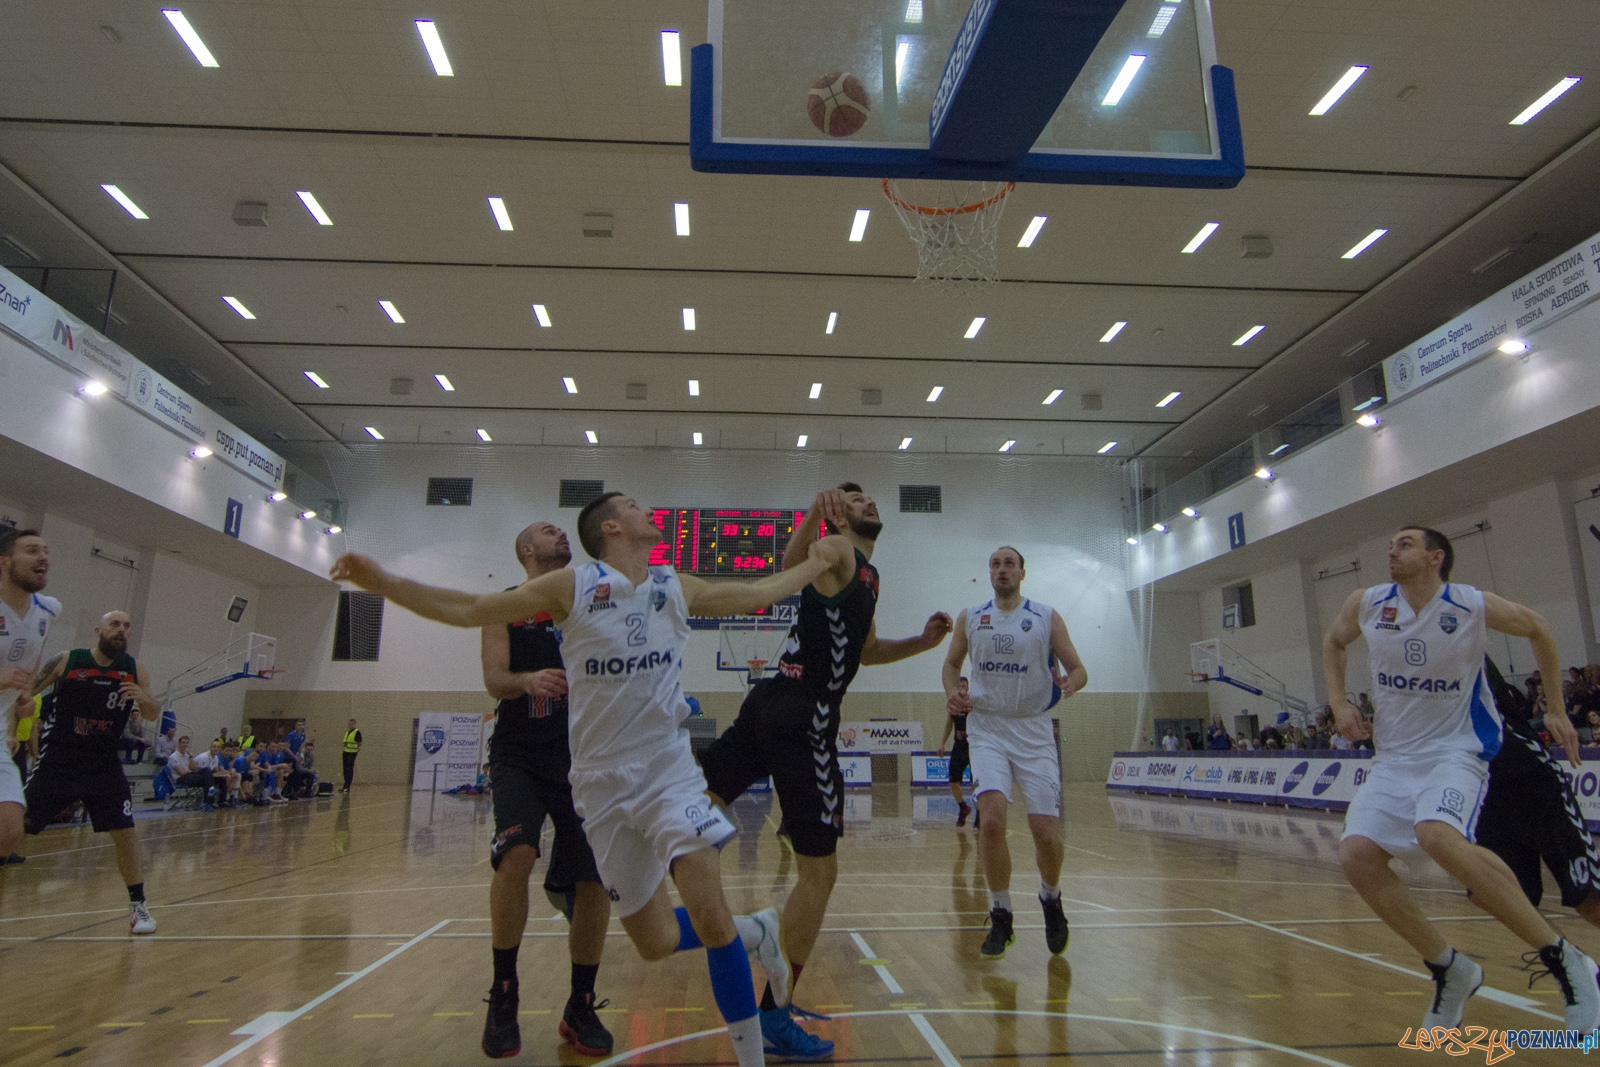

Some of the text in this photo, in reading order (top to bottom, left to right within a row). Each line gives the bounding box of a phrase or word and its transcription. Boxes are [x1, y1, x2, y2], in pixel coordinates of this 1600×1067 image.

[1511, 281, 1535, 302] HALA
[1536, 252, 1584, 287] SPORTOWA
[1516, 280, 1590, 329] BOISKA AEROBIK
[1417, 322, 1473, 359] Centrum Sportu
[1420, 349, 1460, 376] Politechniki
[1462, 321, 1508, 354] Poznańskiej
[156, 383, 177, 405] Centrum
[177, 396, 193, 414] Sportu
[216, 430, 283, 482] cspp.put.poznan.pl
[722, 524, 739, 537] 33
[757, 524, 774, 537] 20
[626, 613, 647, 647] 2
[992, 634, 1014, 654] 12
[1405, 639, 1427, 666] 8
[585, 649, 672, 676] BIOFARM
[1378, 672, 1461, 693] BIOFARM
[106, 692, 127, 711] 84
[870, 729, 910, 738] MAXXX
[1147, 763, 1177, 776] BIOFARM
